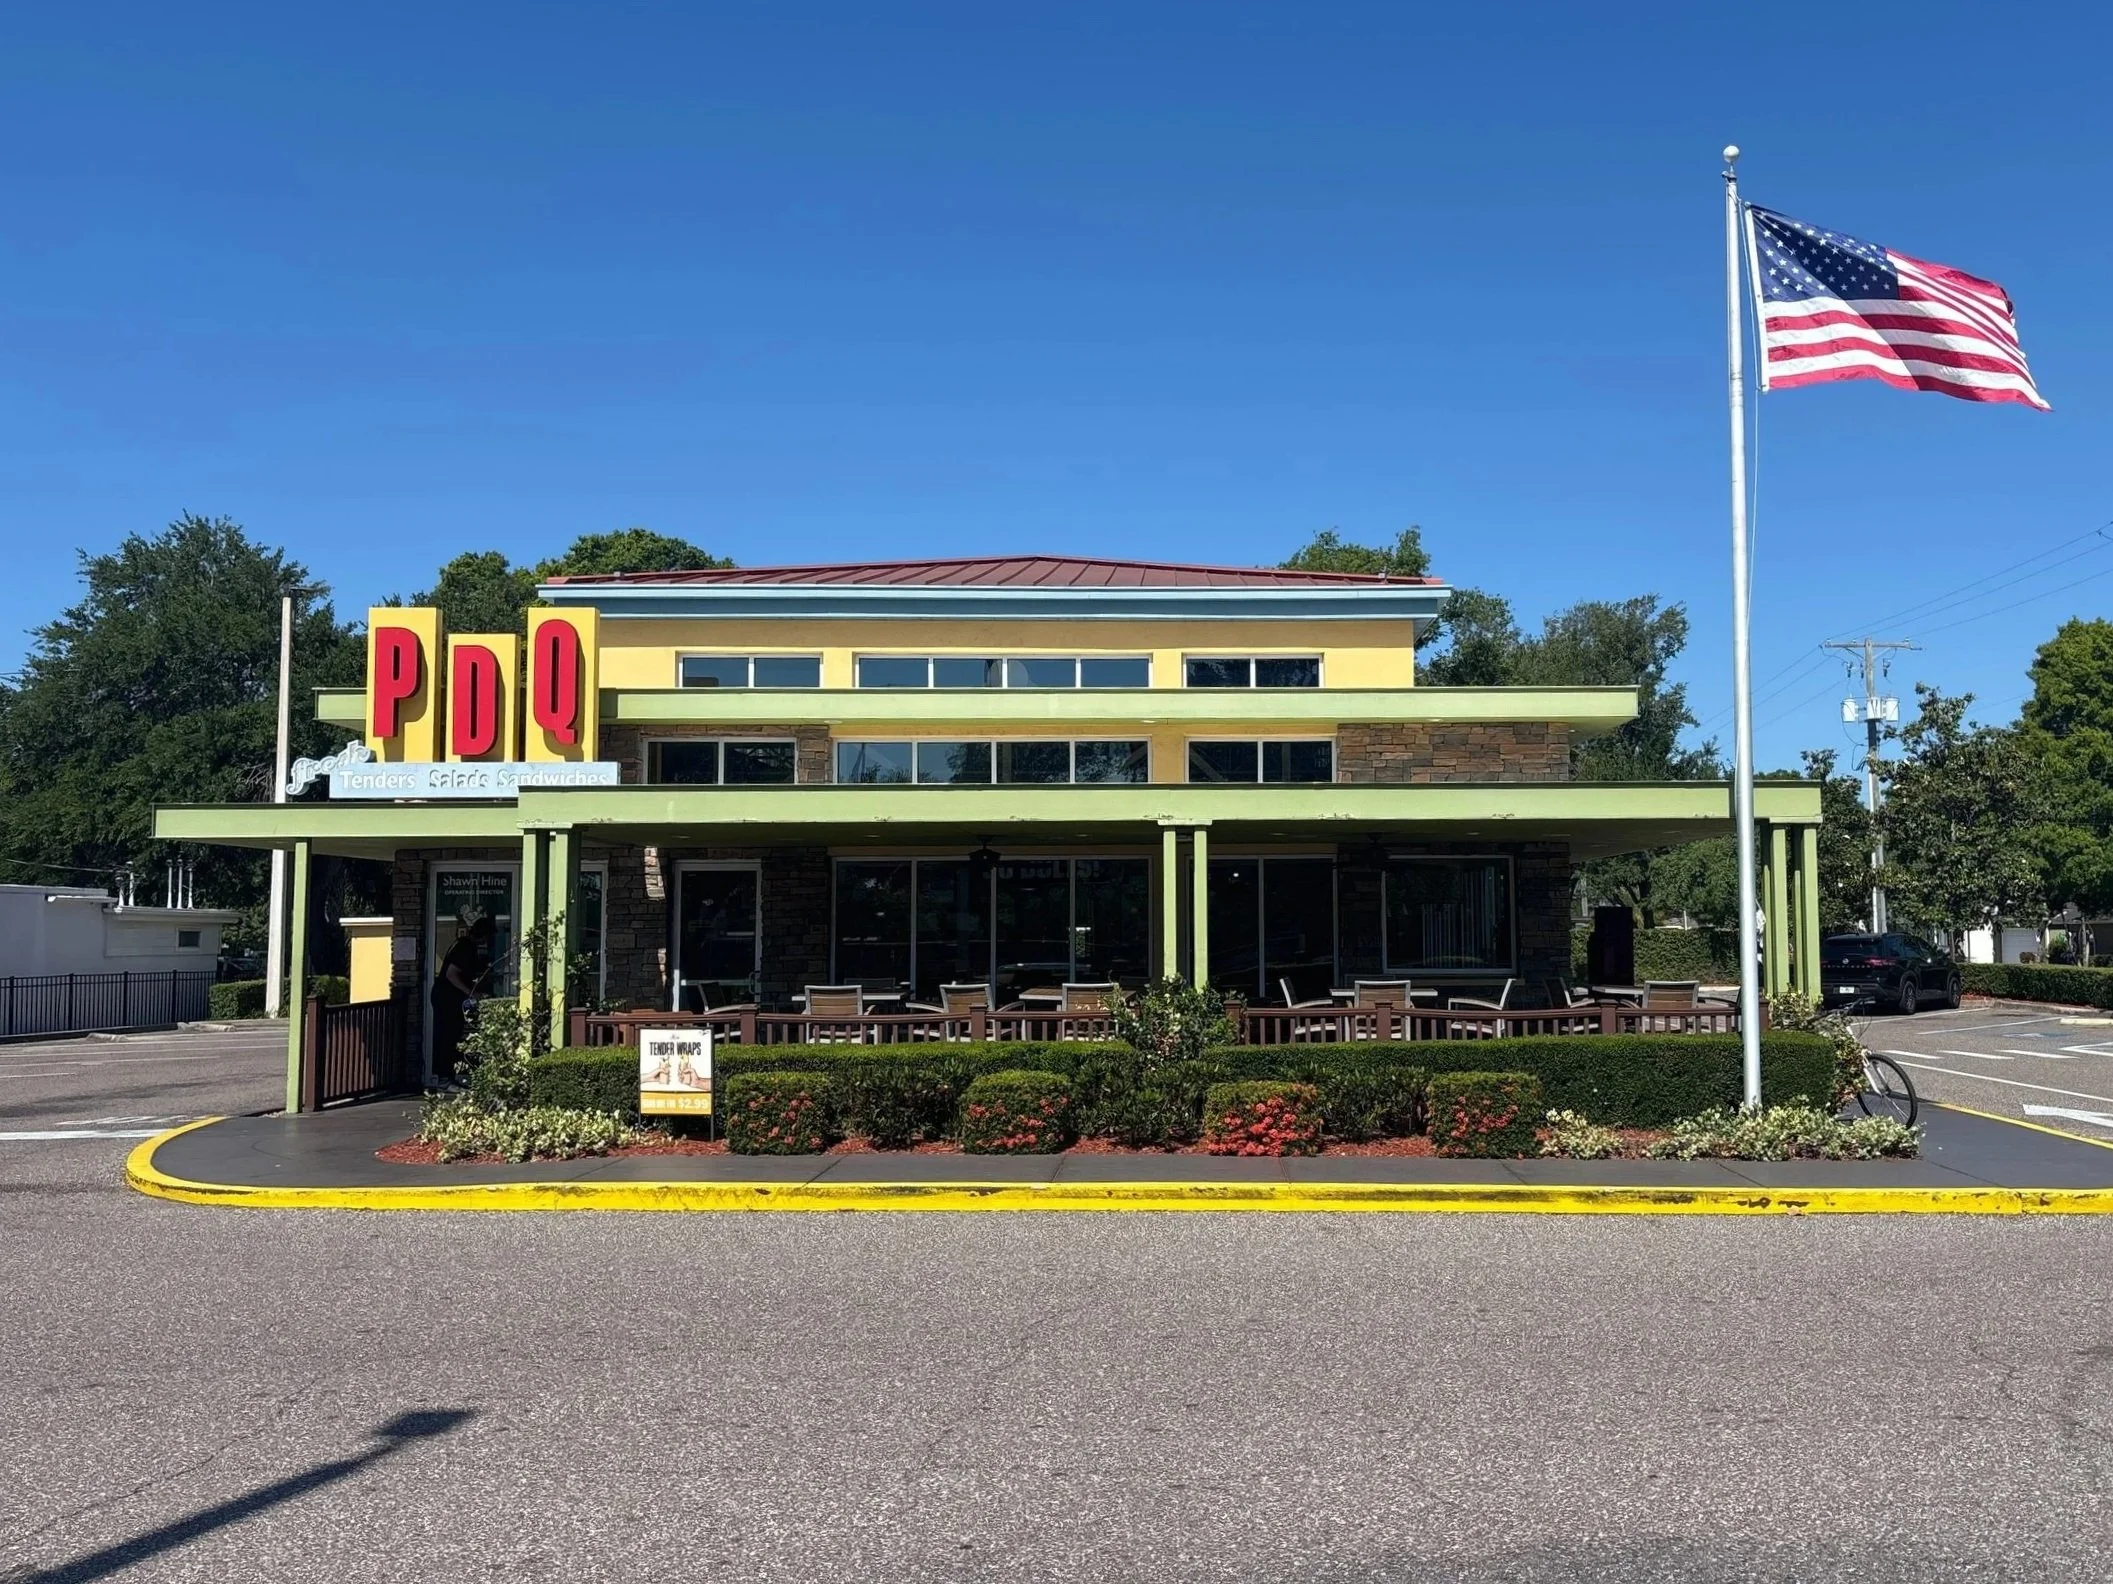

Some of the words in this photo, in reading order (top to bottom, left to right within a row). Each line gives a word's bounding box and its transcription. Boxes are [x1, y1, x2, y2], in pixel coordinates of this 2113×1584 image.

[373, 618, 579, 757] PDQ
[286, 739, 372, 796] fresh
[340, 769, 416, 789] Tenders
[429, 768, 489, 789] Salads
[497, 768, 609, 787] Sandwiches
[443, 874, 478, 887] Shawn
[481, 874, 507, 887] Hine
[649, 1041, 675, 1056] TENDER
[676, 1041, 702, 1056] WRAPS
